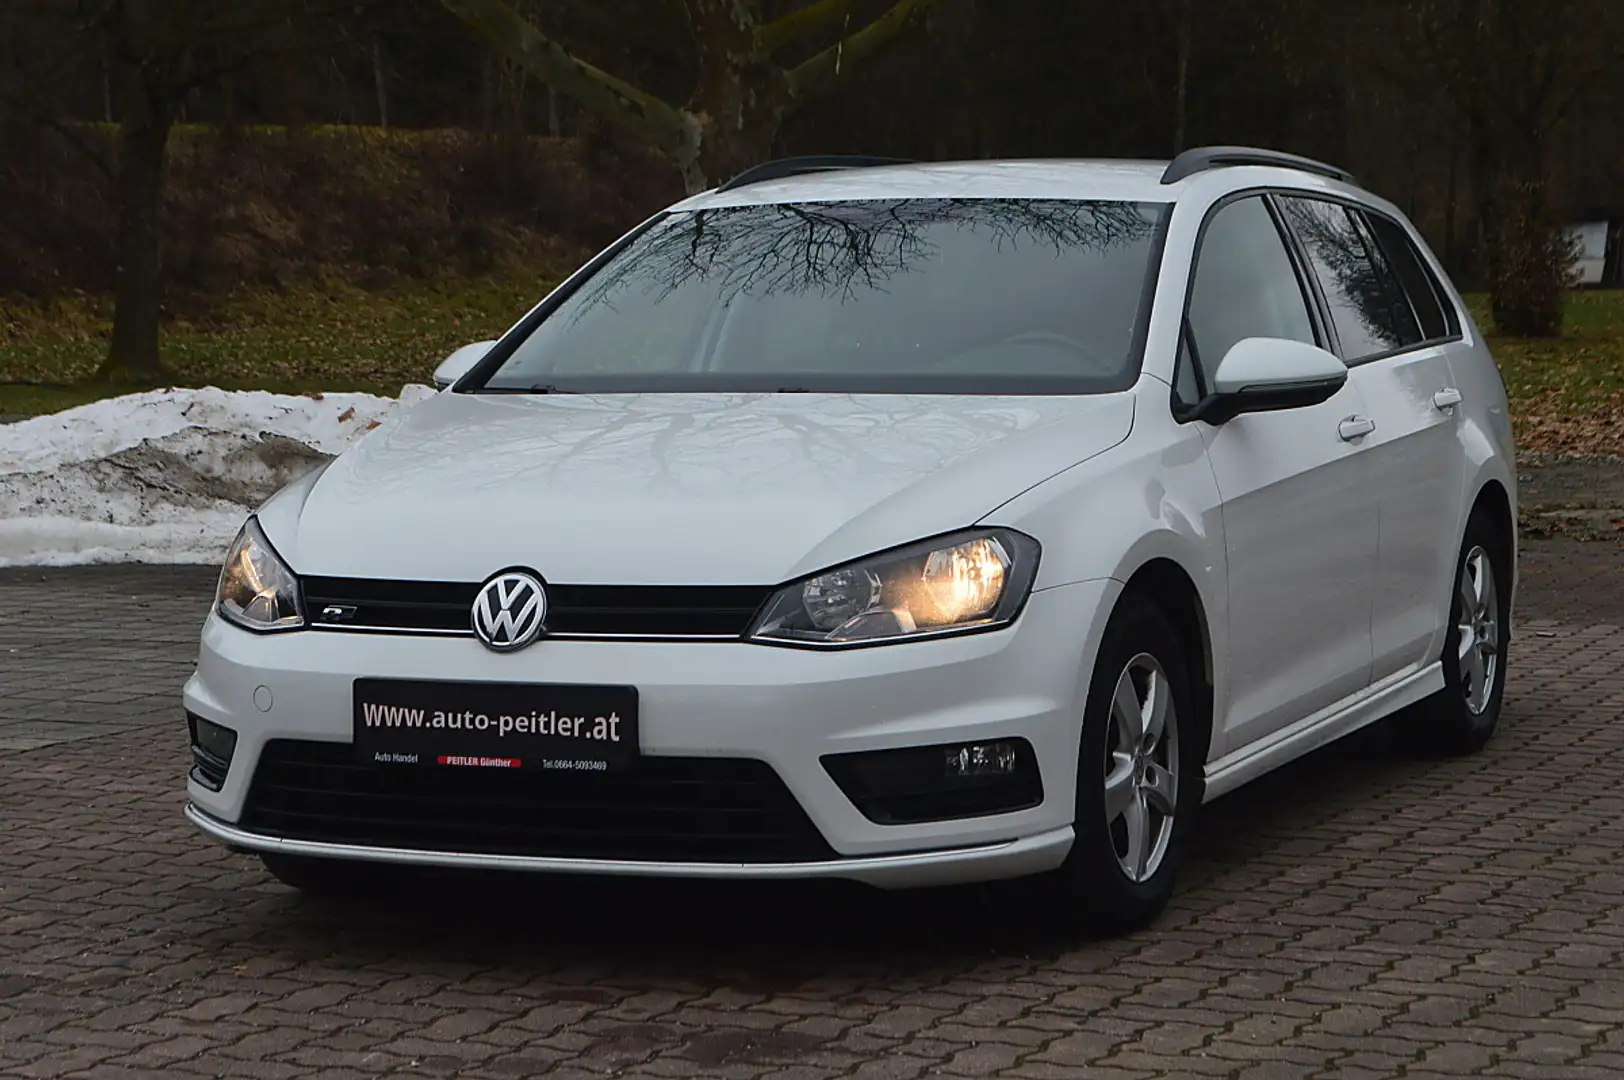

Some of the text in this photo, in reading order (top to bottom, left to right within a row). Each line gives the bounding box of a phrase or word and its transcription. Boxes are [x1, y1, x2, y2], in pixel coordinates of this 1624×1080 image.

[375, 752, 418, 763] Auto Handel
[447, 756, 479, 766] PEITLER
